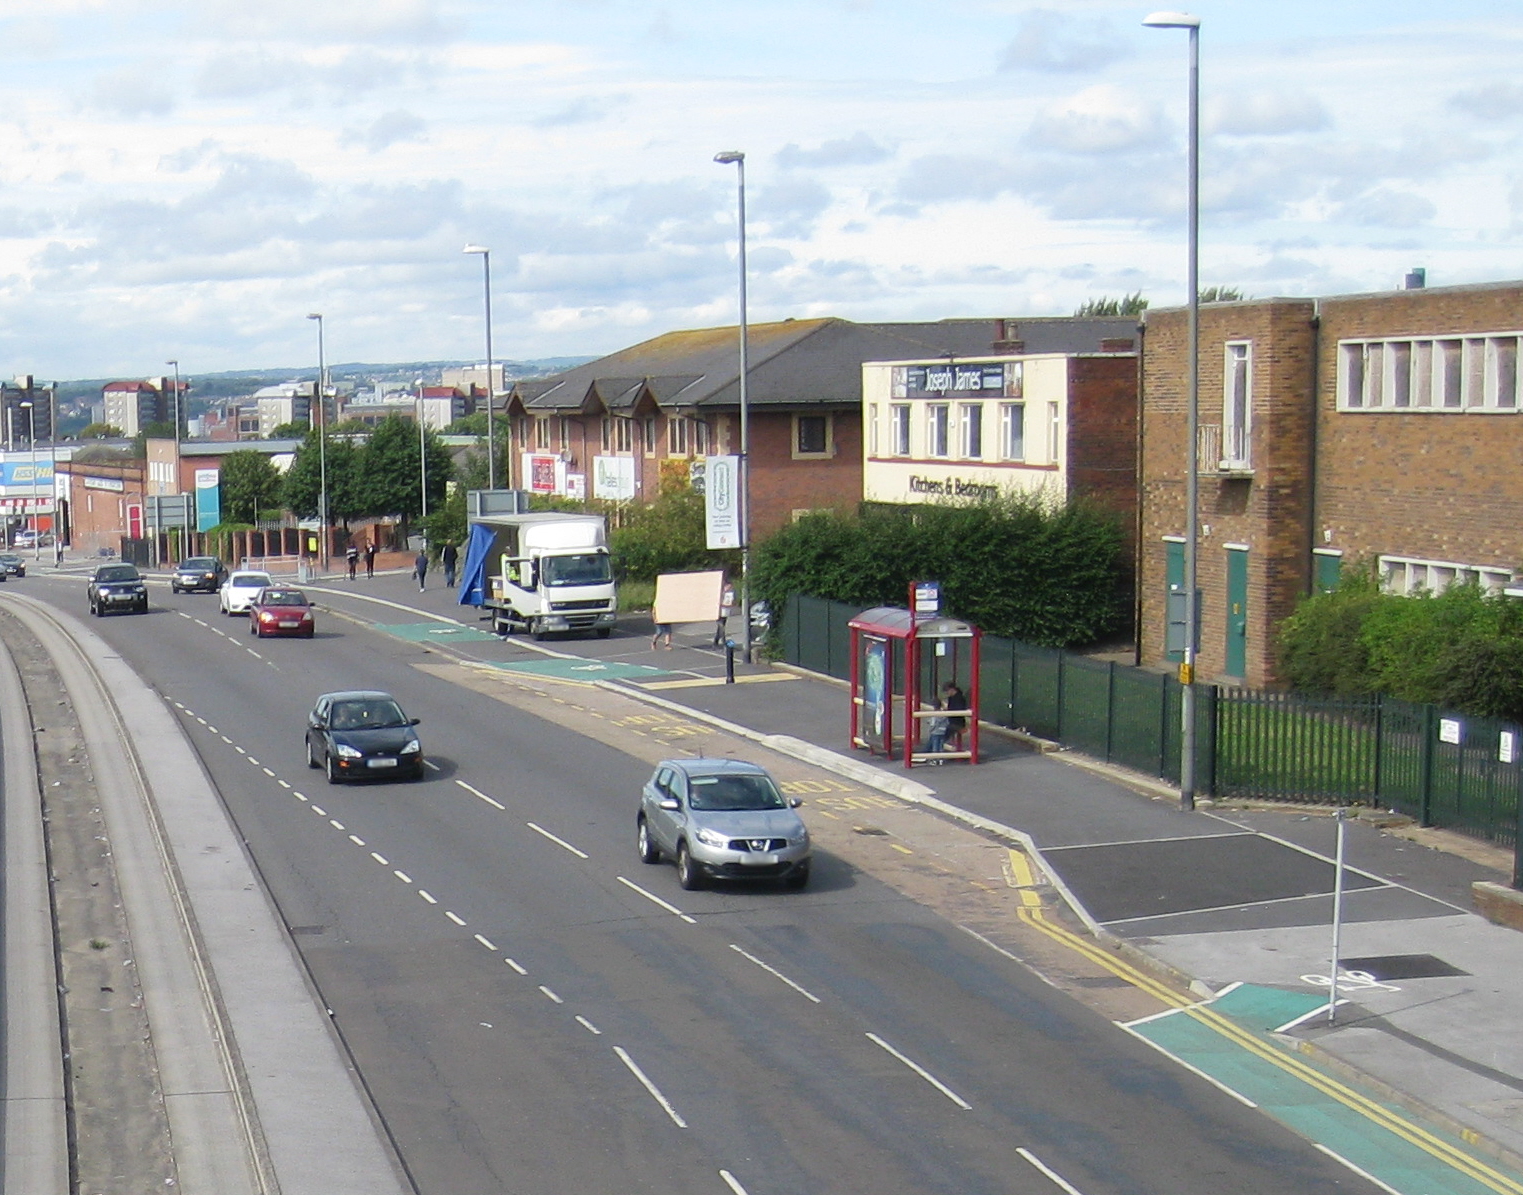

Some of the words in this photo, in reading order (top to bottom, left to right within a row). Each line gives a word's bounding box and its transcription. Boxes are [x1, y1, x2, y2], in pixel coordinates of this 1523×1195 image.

[925, 367, 952, 396] Joseph
[954, 366, 981, 391] James
[909, 475, 943, 495] Kitchens
[945, 476, 952, 495] &
[954, 477, 998, 500] Bedrooms
